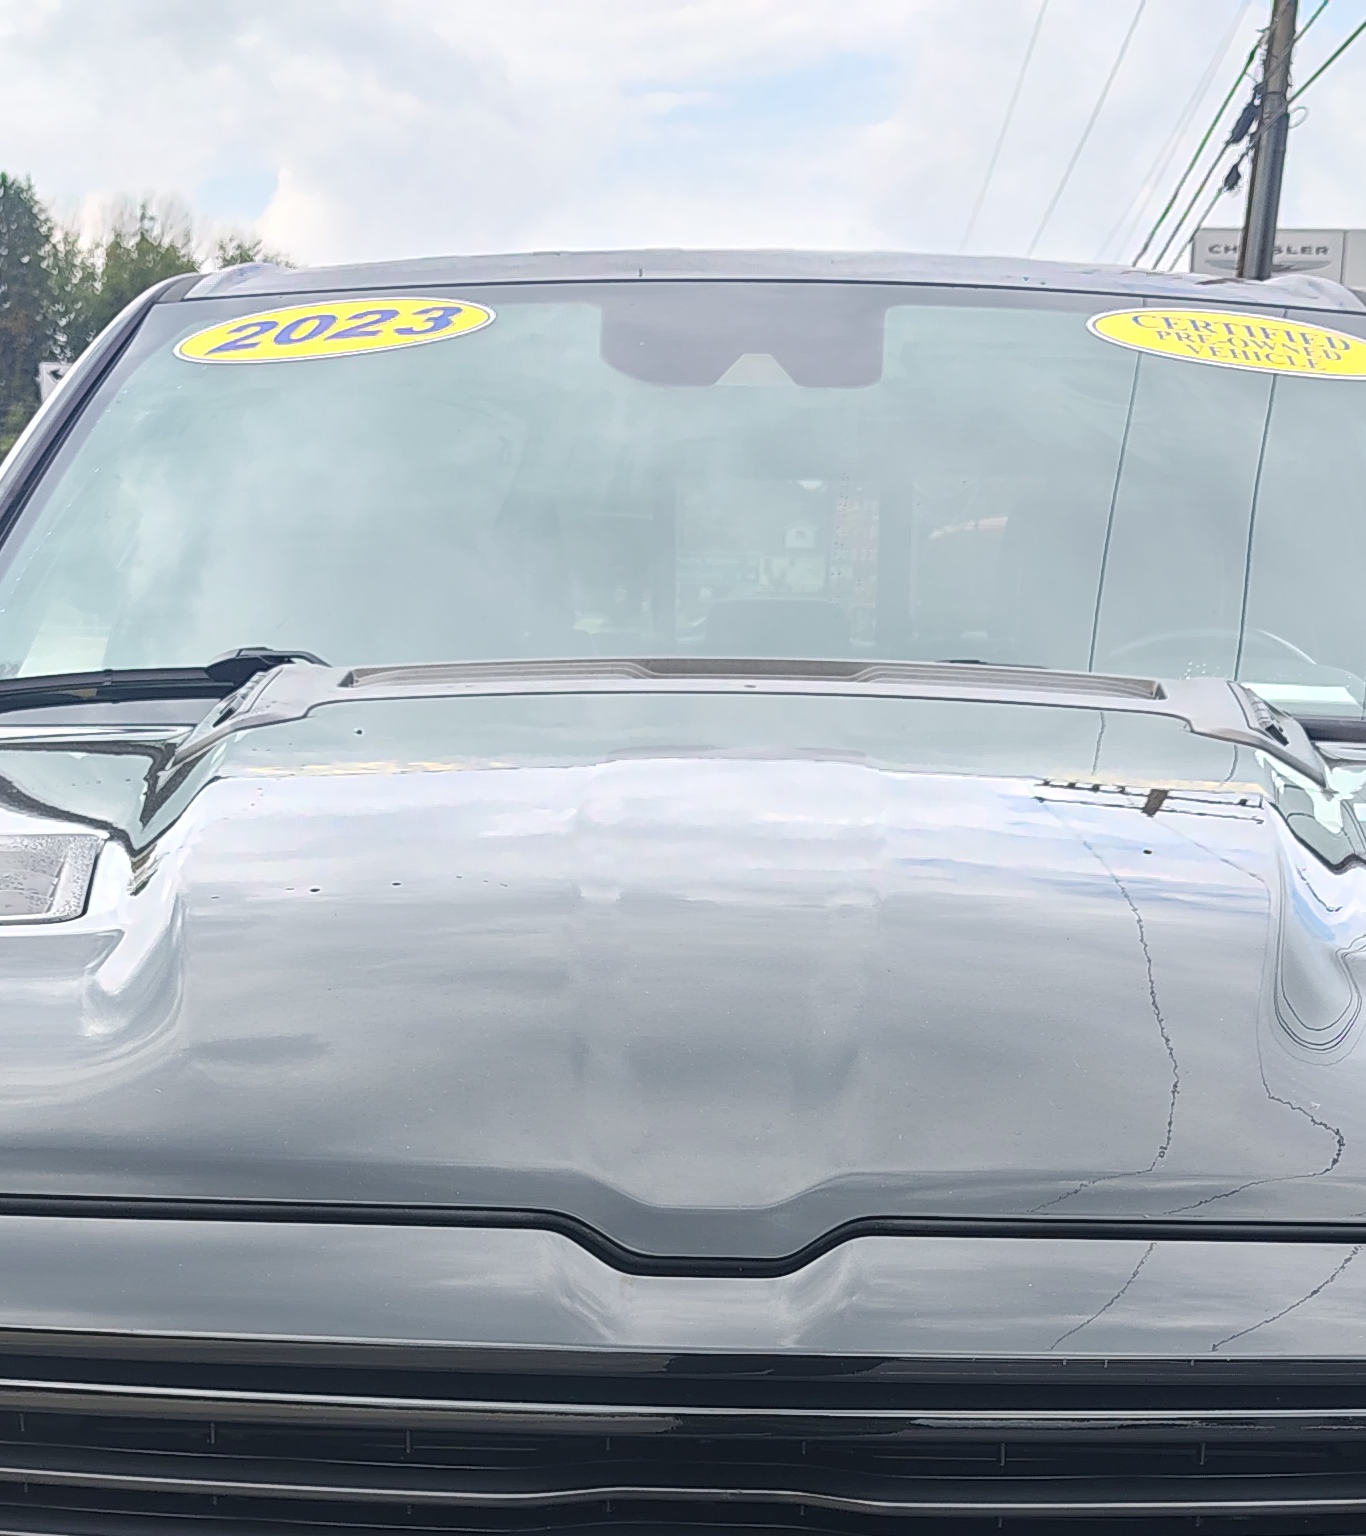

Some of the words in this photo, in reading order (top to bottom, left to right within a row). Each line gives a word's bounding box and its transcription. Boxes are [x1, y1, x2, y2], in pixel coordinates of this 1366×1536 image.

[1207, 244, 1329, 256] CHSLER
[204, 306, 464, 356] 2023
[1131, 314, 1350, 351] CERTIFIED
[1155, 330, 1342, 361] PRE-OWNED
[1185, 343, 1326, 371] VEHICLE
